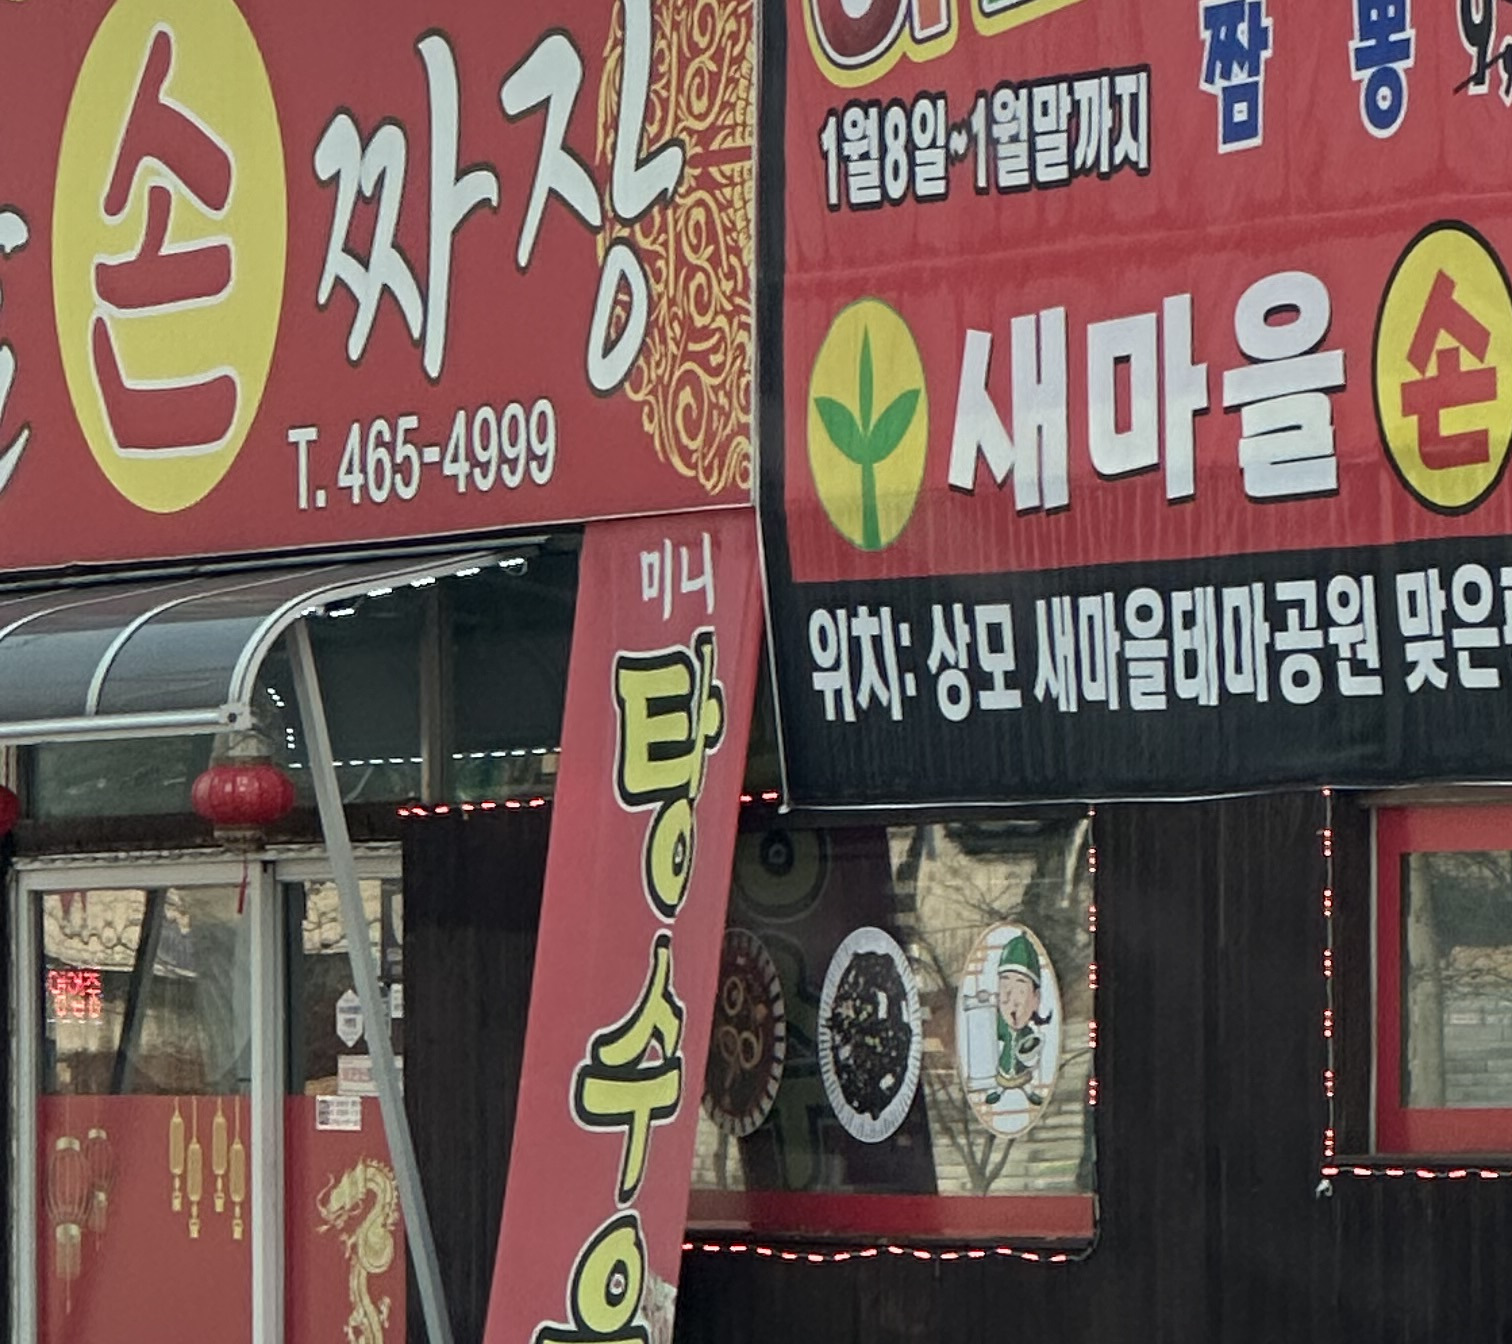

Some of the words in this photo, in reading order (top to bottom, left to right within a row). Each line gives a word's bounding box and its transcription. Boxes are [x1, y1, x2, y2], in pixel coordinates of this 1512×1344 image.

[88, 22, 239, 457] 손
[948, 270, 1346, 513] 새마을
[1400, 268, 1498, 471] 손
[640, 532, 714, 621] 미니
[807, 607, 918, 723] 위치:
[927, 603, 1022, 723] 상모
[1034, 574, 1383, 713] 새마을테마공원
